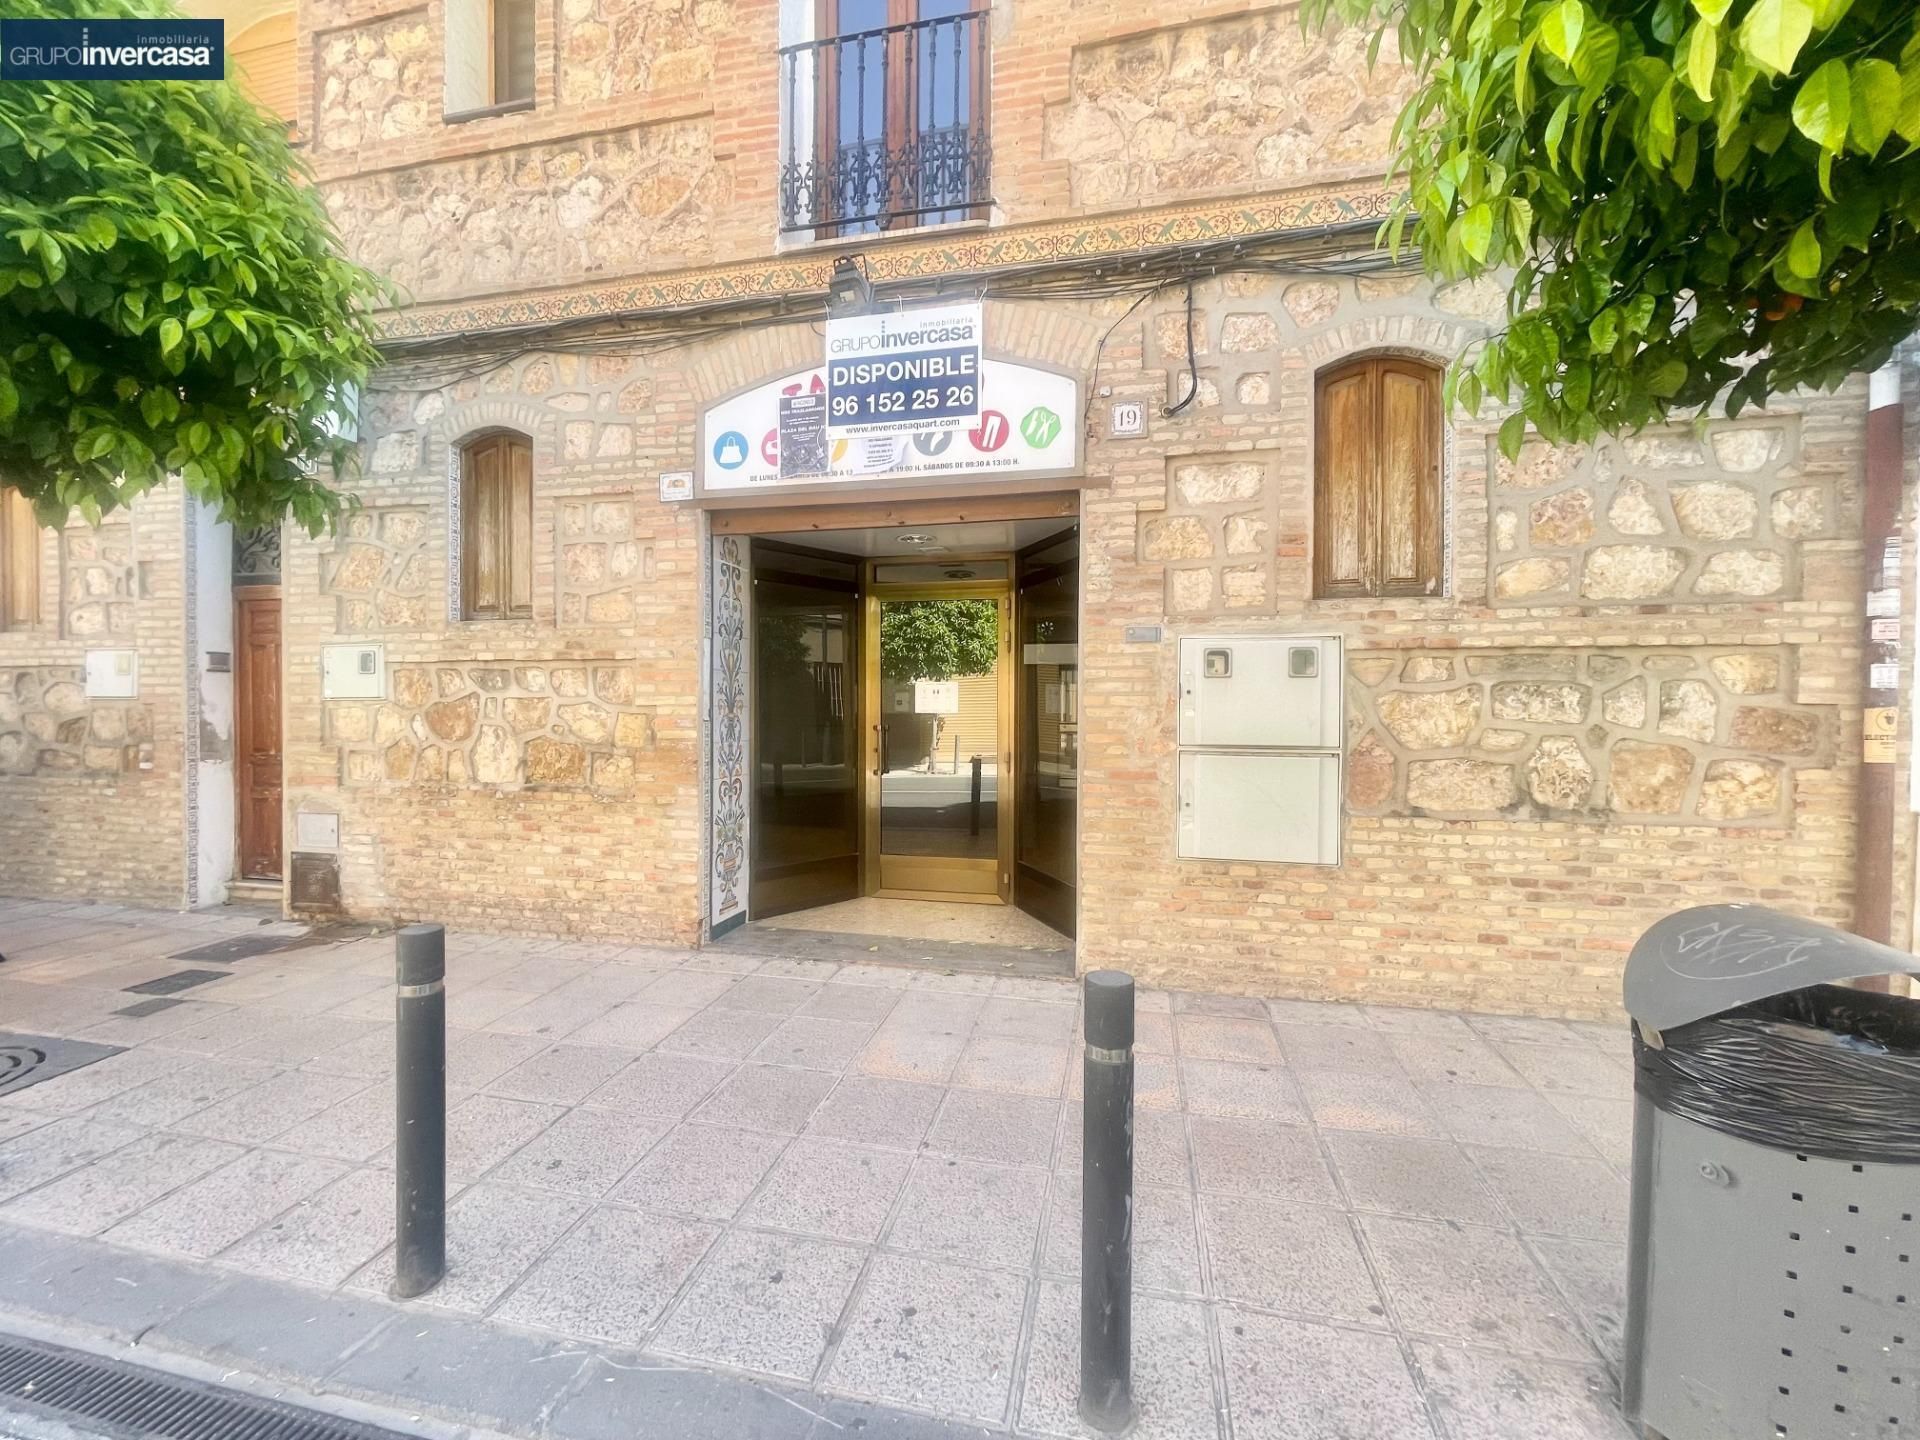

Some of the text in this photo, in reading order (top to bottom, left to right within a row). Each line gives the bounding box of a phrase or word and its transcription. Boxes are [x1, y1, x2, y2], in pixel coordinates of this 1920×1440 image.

[919, 316, 974, 328] inmobiliaria
[833, 354, 975, 386] DISPONIBLE
[832, 395, 859, 416] 96
[866, 391, 906, 414] 152
[912, 388, 940, 410] 25
[946, 385, 974, 407] 26
[846, 418, 960, 434] www.invercasaquart.com
[1120, 409, 1136, 427] 19
